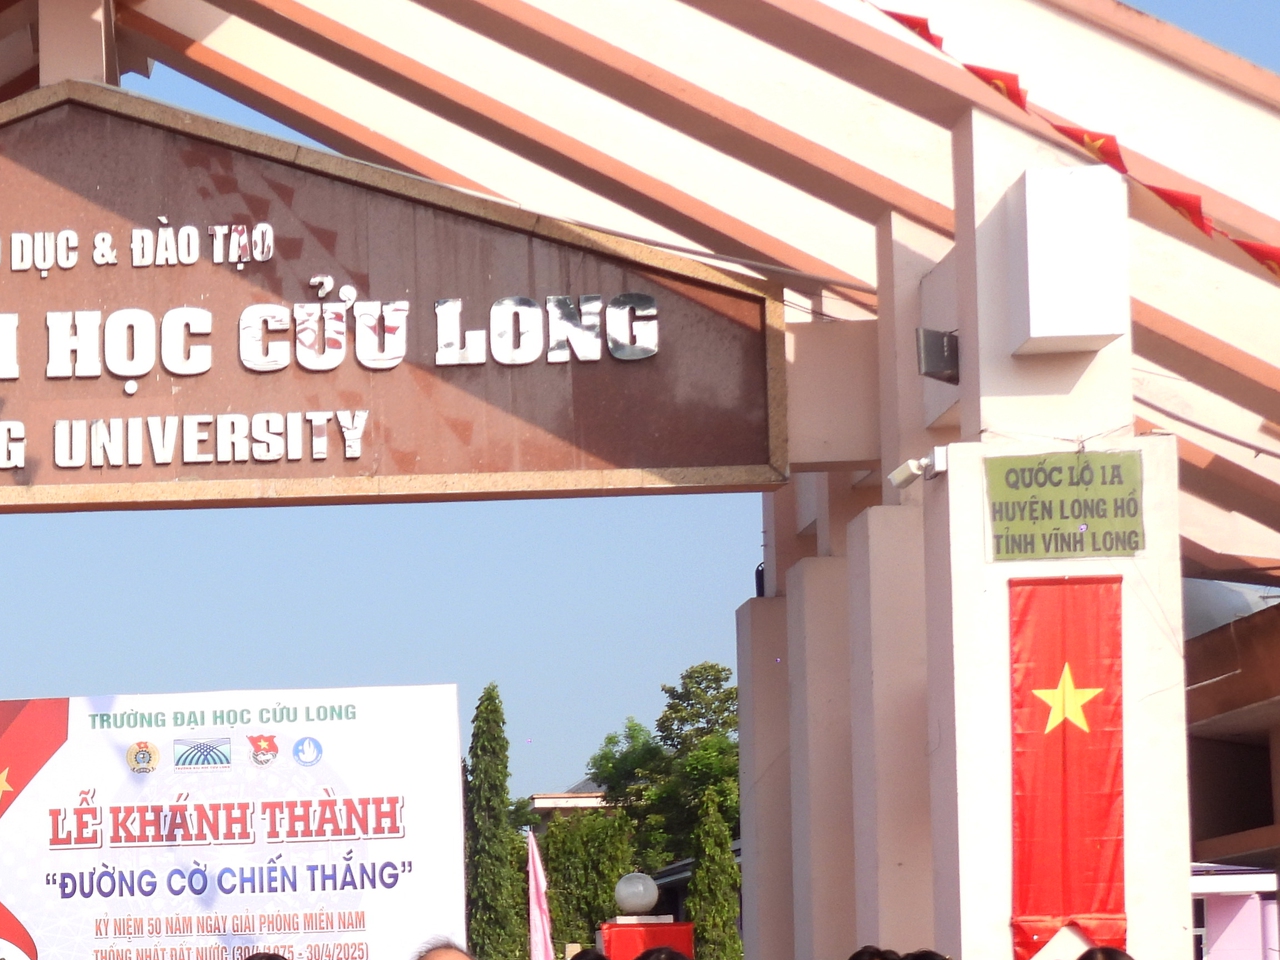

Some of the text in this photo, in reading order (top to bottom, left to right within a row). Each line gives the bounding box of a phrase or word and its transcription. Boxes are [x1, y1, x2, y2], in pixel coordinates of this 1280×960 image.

[10, 229, 80, 278] DỤC
[92, 231, 118, 265] &
[130, 217, 200, 268] ĐÀO
[208, 223, 275, 271] TẠO
[45, 305, 213, 395] HỌC
[238, 274, 409, 372] CỬU
[433, 292, 660, 367] LONG
[54, 409, 370, 468] UNIVERSITY
[1005, 459, 1064, 491] QUỐC
[1067, 460, 1095, 492] LỘ
[992, 488, 1139, 525] HUYỆN LONG HỒ
[993, 527, 1140, 555] TỈNH VĨNH LONG
[88, 702, 357, 731] TRƯỜNG ĐẠI HỌC CỬU LONG
[48, 788, 405, 848] LỄ KHÁNH THÀNH
[166, 859, 209, 897] CỜ
[216, 853, 298, 895] CHIẾN
[94, 906, 366, 940] KỶ NIỆM 50 NĂM NGÀY GIẢI PHÓNG MIỀN NAM
